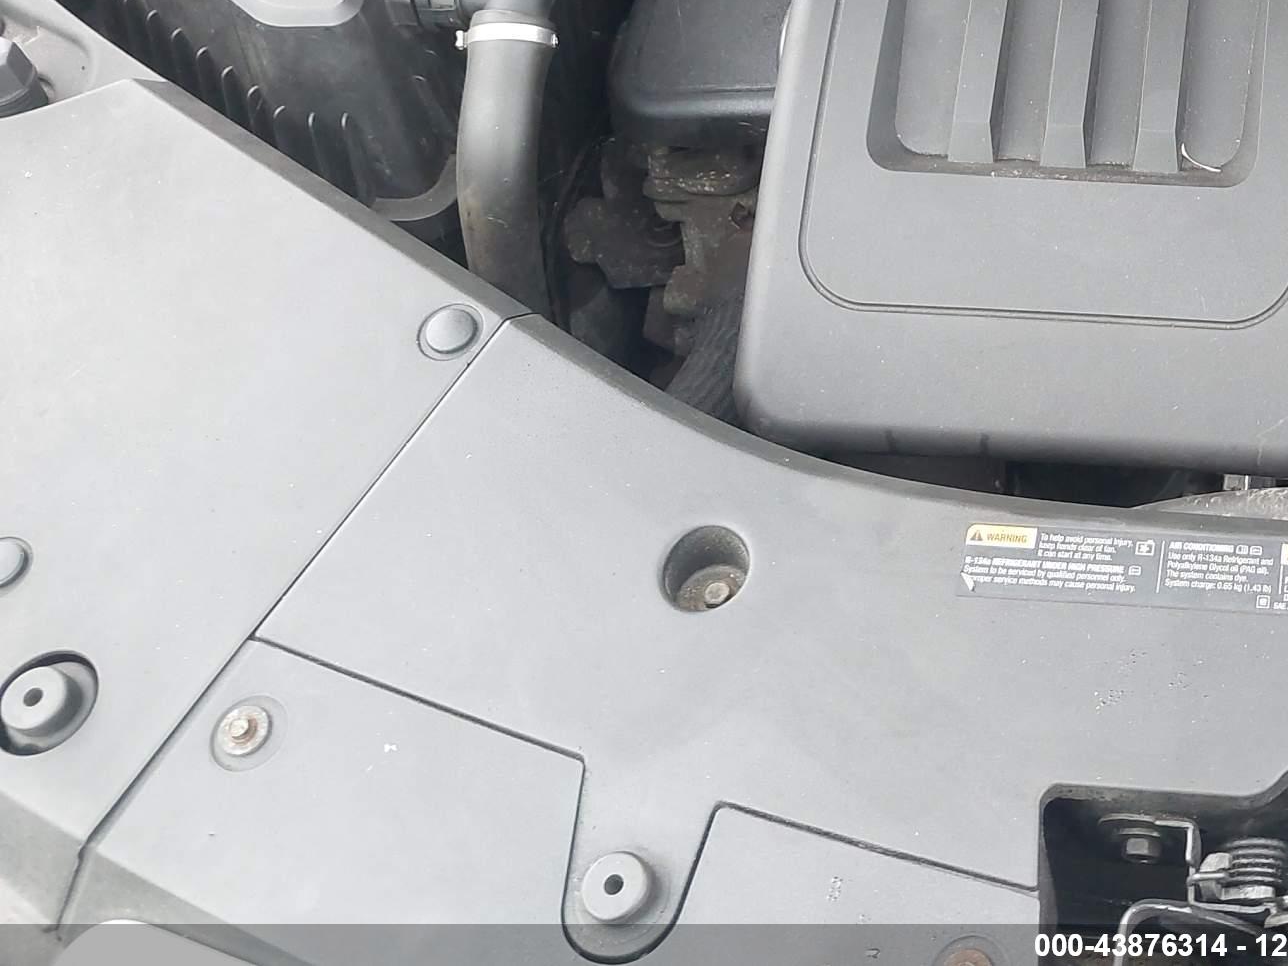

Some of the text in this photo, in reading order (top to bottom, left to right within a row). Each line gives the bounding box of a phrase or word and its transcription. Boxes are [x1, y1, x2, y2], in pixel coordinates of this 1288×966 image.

[987, 533, 1028, 544] WARNING
[1197, 553, 1222, 563] R-134a
[963, 564, 989, 574] System
